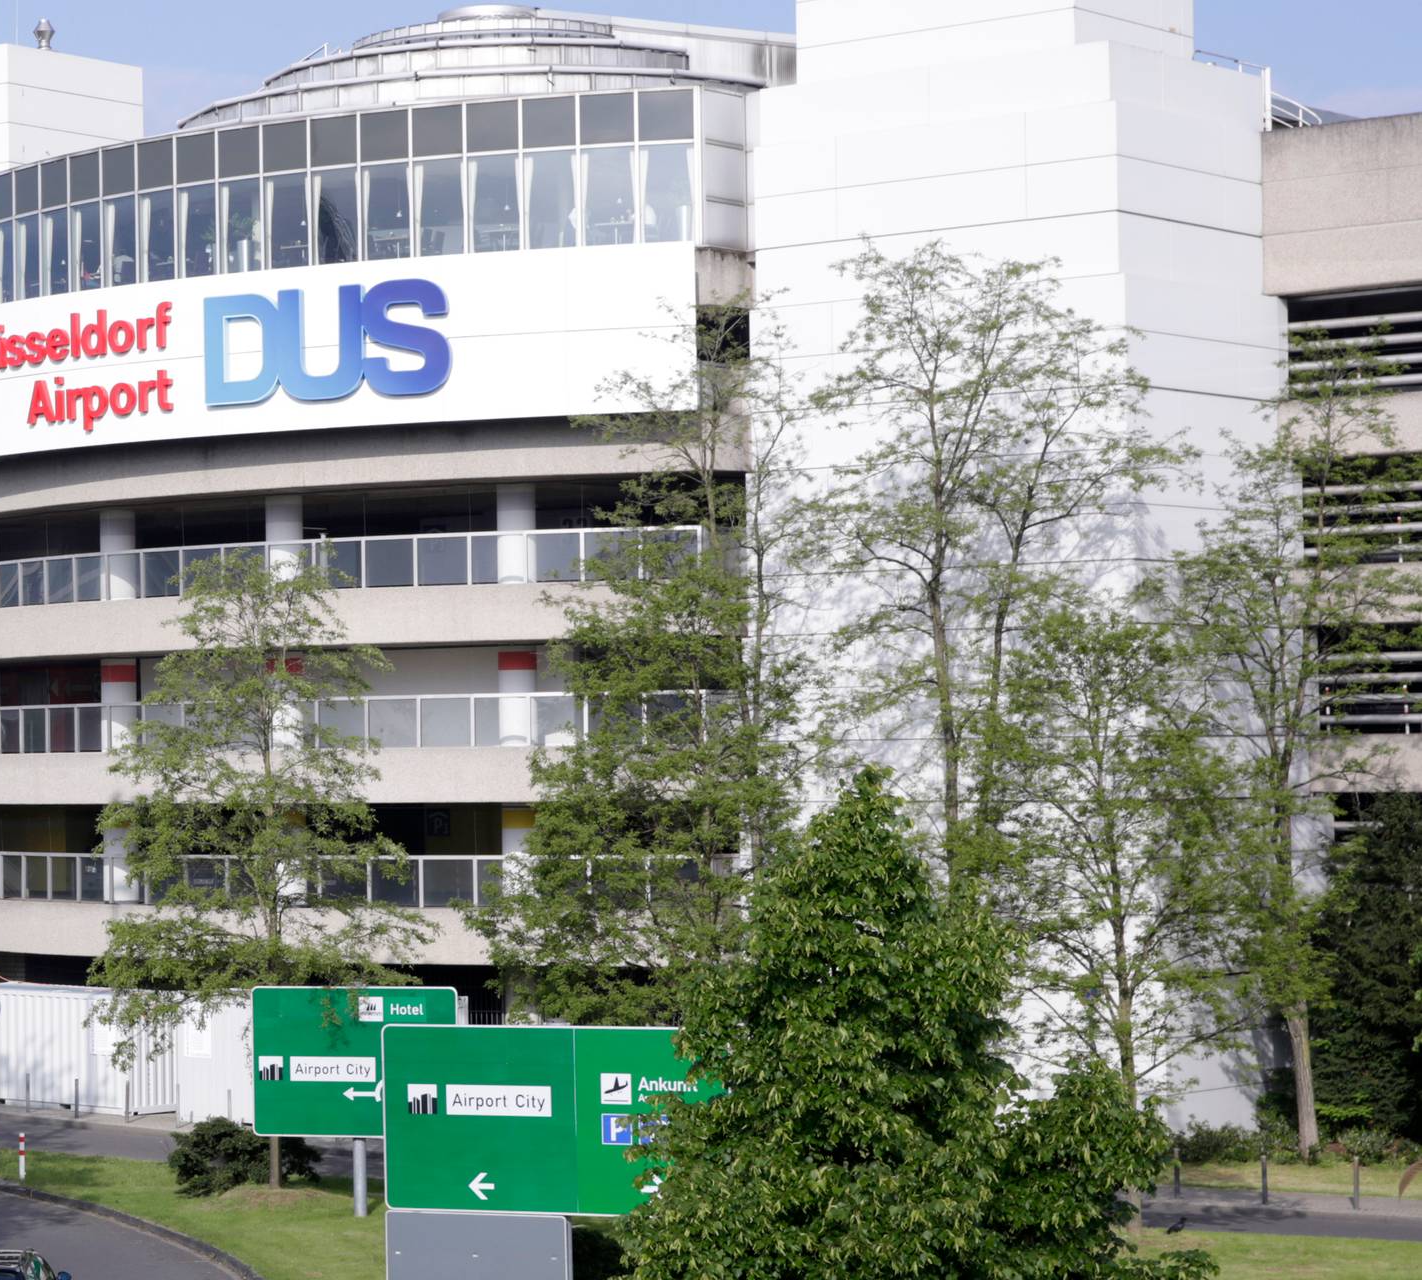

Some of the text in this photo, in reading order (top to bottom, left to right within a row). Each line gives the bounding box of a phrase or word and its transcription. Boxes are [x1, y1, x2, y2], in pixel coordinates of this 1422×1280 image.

[203, 277, 453, 407] DUS
[27, 369, 175, 433] Airport
[389, 1003, 425, 1016] Hotel
[294, 1063, 372, 1078] Airport City
[638, 1076, 699, 1093] Ankunt
[452, 1093, 546, 1112] Airport City
